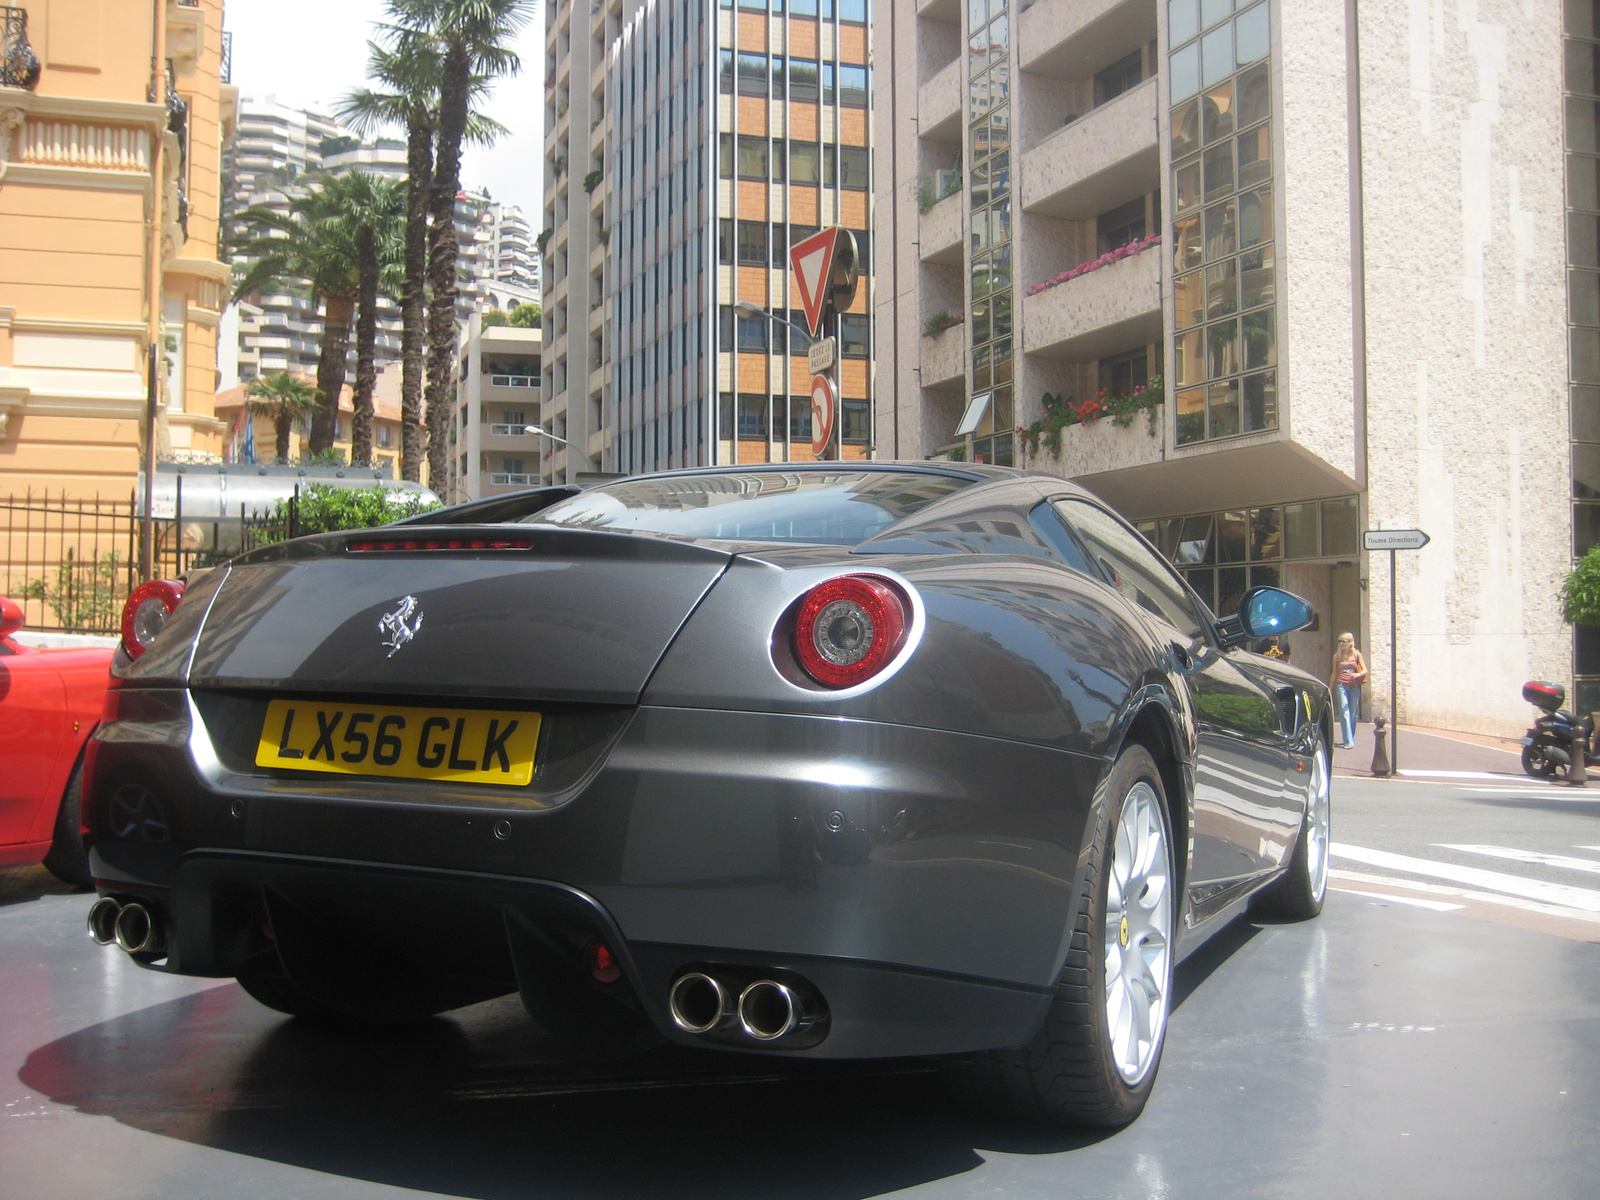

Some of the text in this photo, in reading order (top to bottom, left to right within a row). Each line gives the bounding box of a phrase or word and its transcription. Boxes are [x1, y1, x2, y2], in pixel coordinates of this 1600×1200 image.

[811, 354, 830, 368] PASSAGE
[277, 708, 519, 773] LX56 GLK
